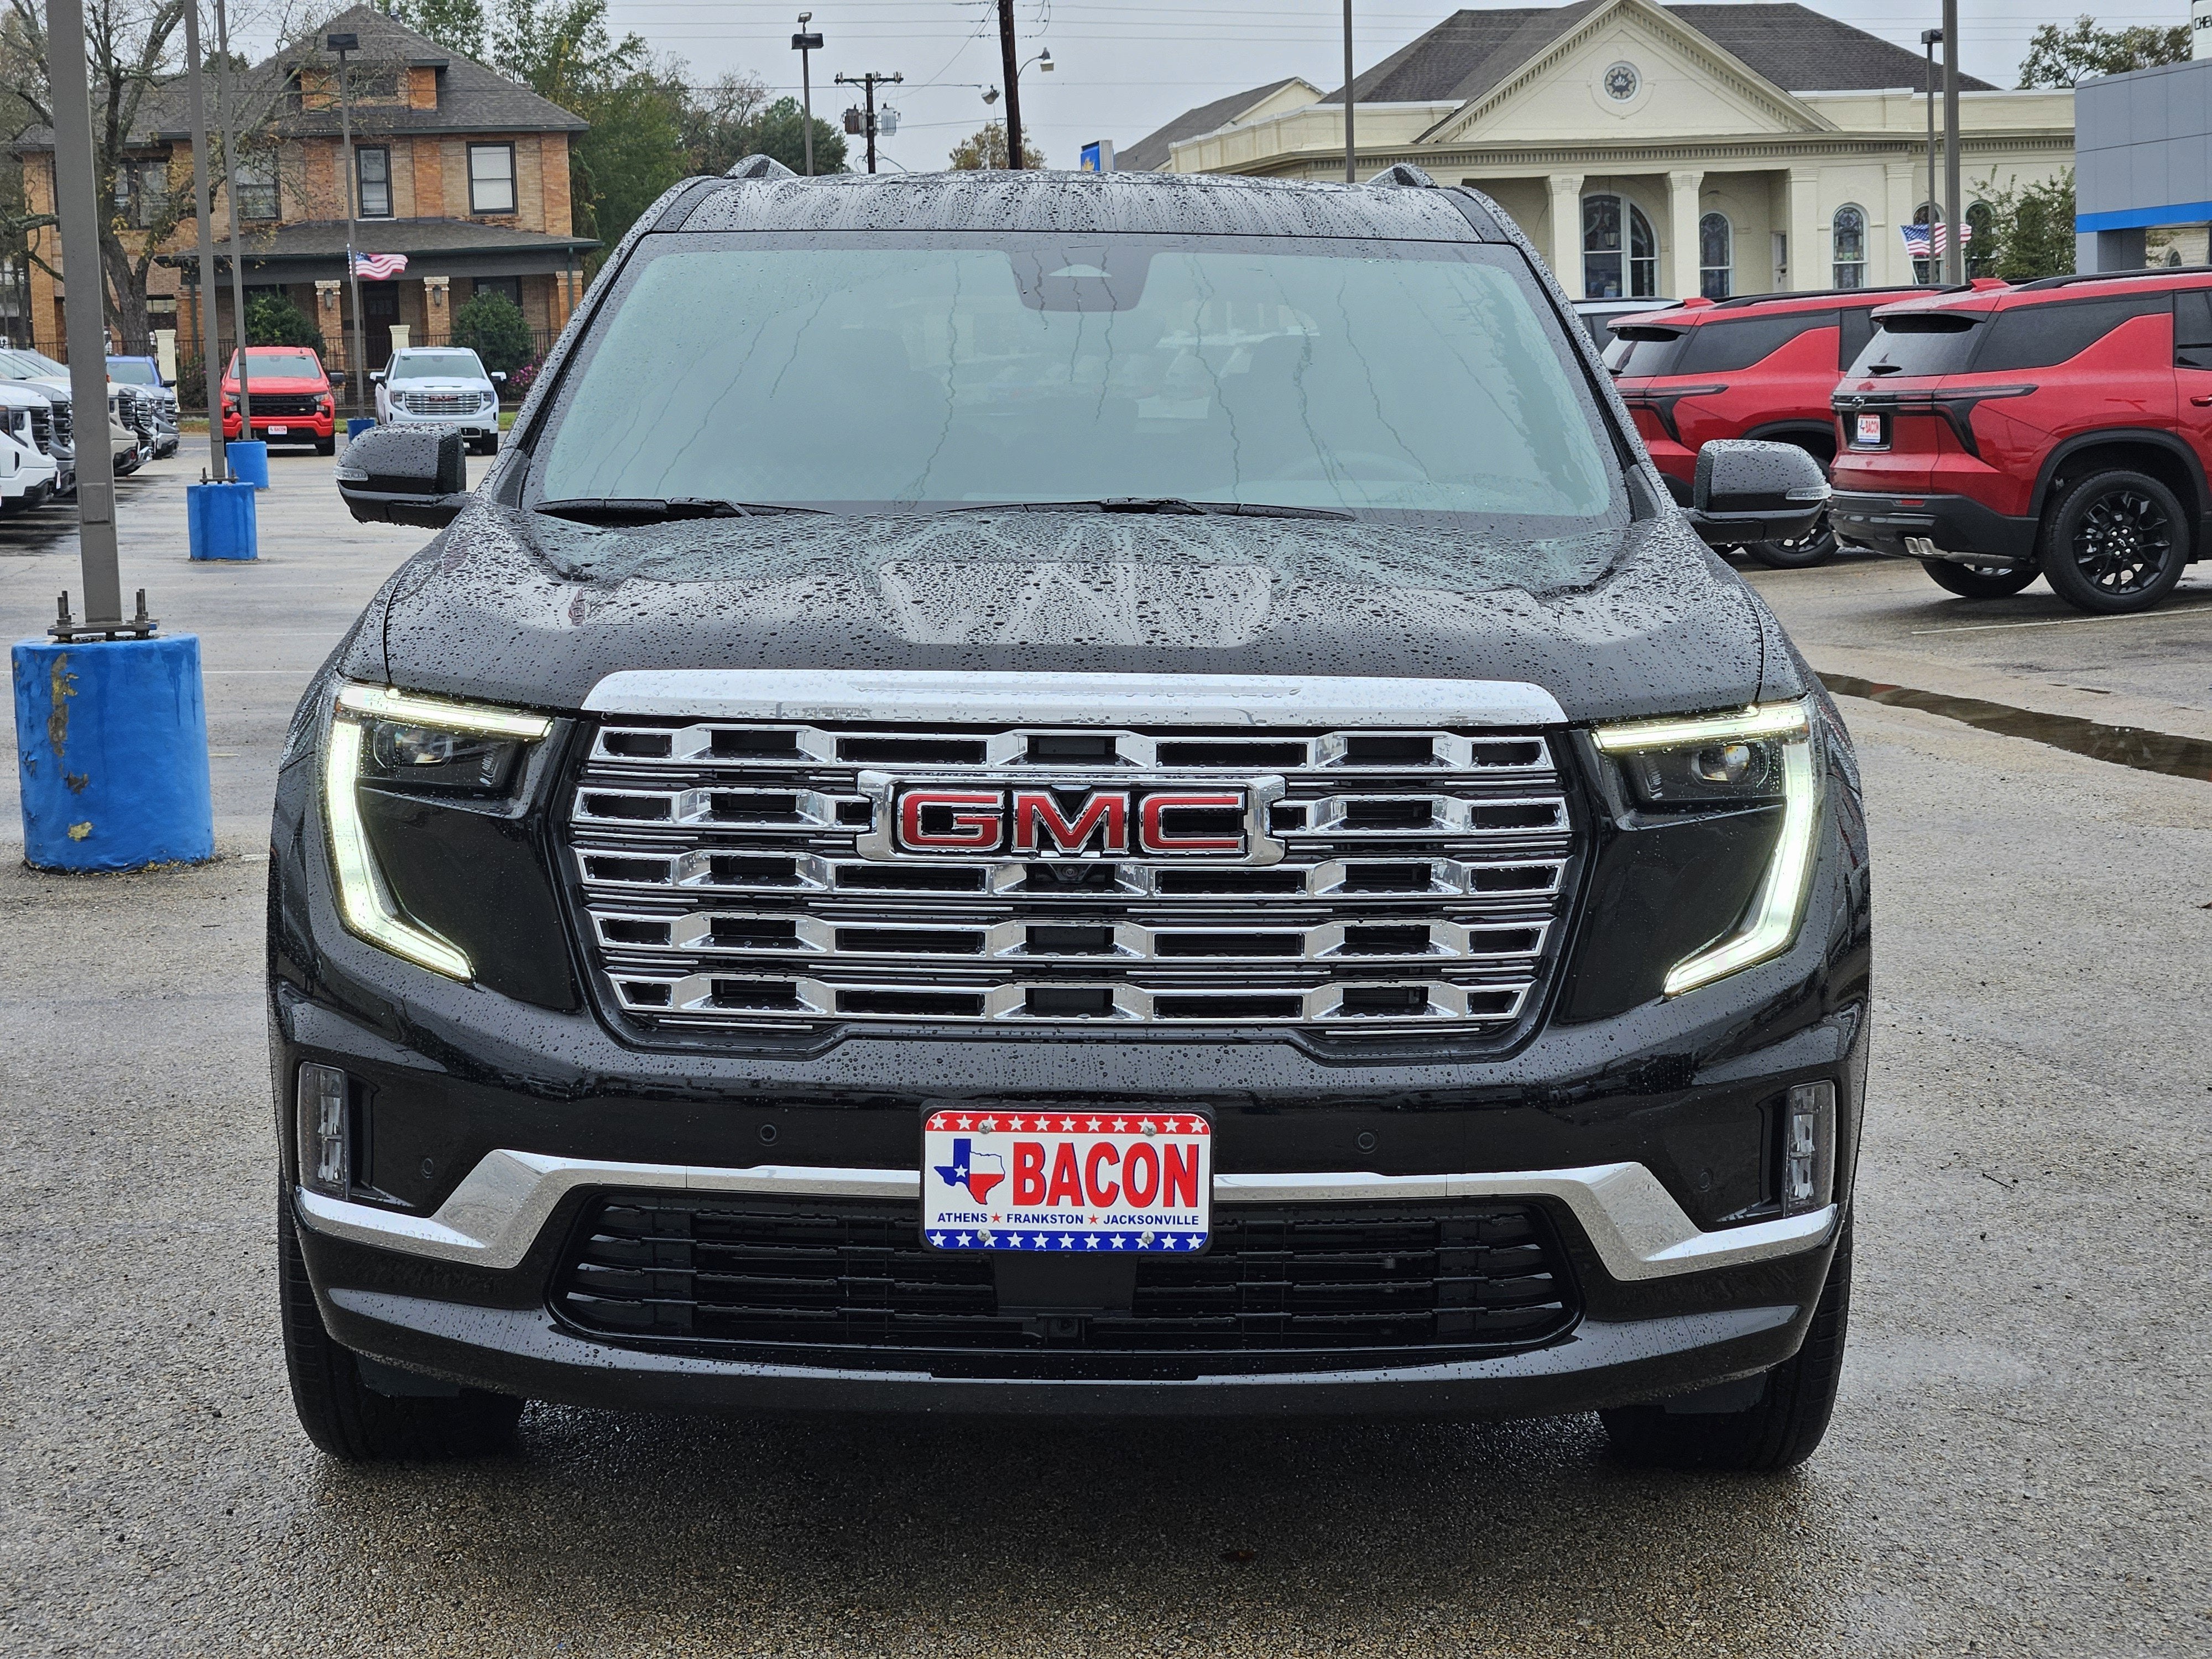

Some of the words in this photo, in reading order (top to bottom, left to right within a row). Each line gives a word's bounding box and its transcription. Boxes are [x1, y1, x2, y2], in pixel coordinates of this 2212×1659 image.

[2194, 15, 2212, 30] CHE
[897, 790, 1246, 855] GMC
[1013, 1141, 1199, 1208] BACON
[937, 1212, 988, 1223] ATHENS
[1006, 1213, 1083, 1225] FRANKSTON
[1103, 1214, 1199, 1225] JACKSONVILLE
